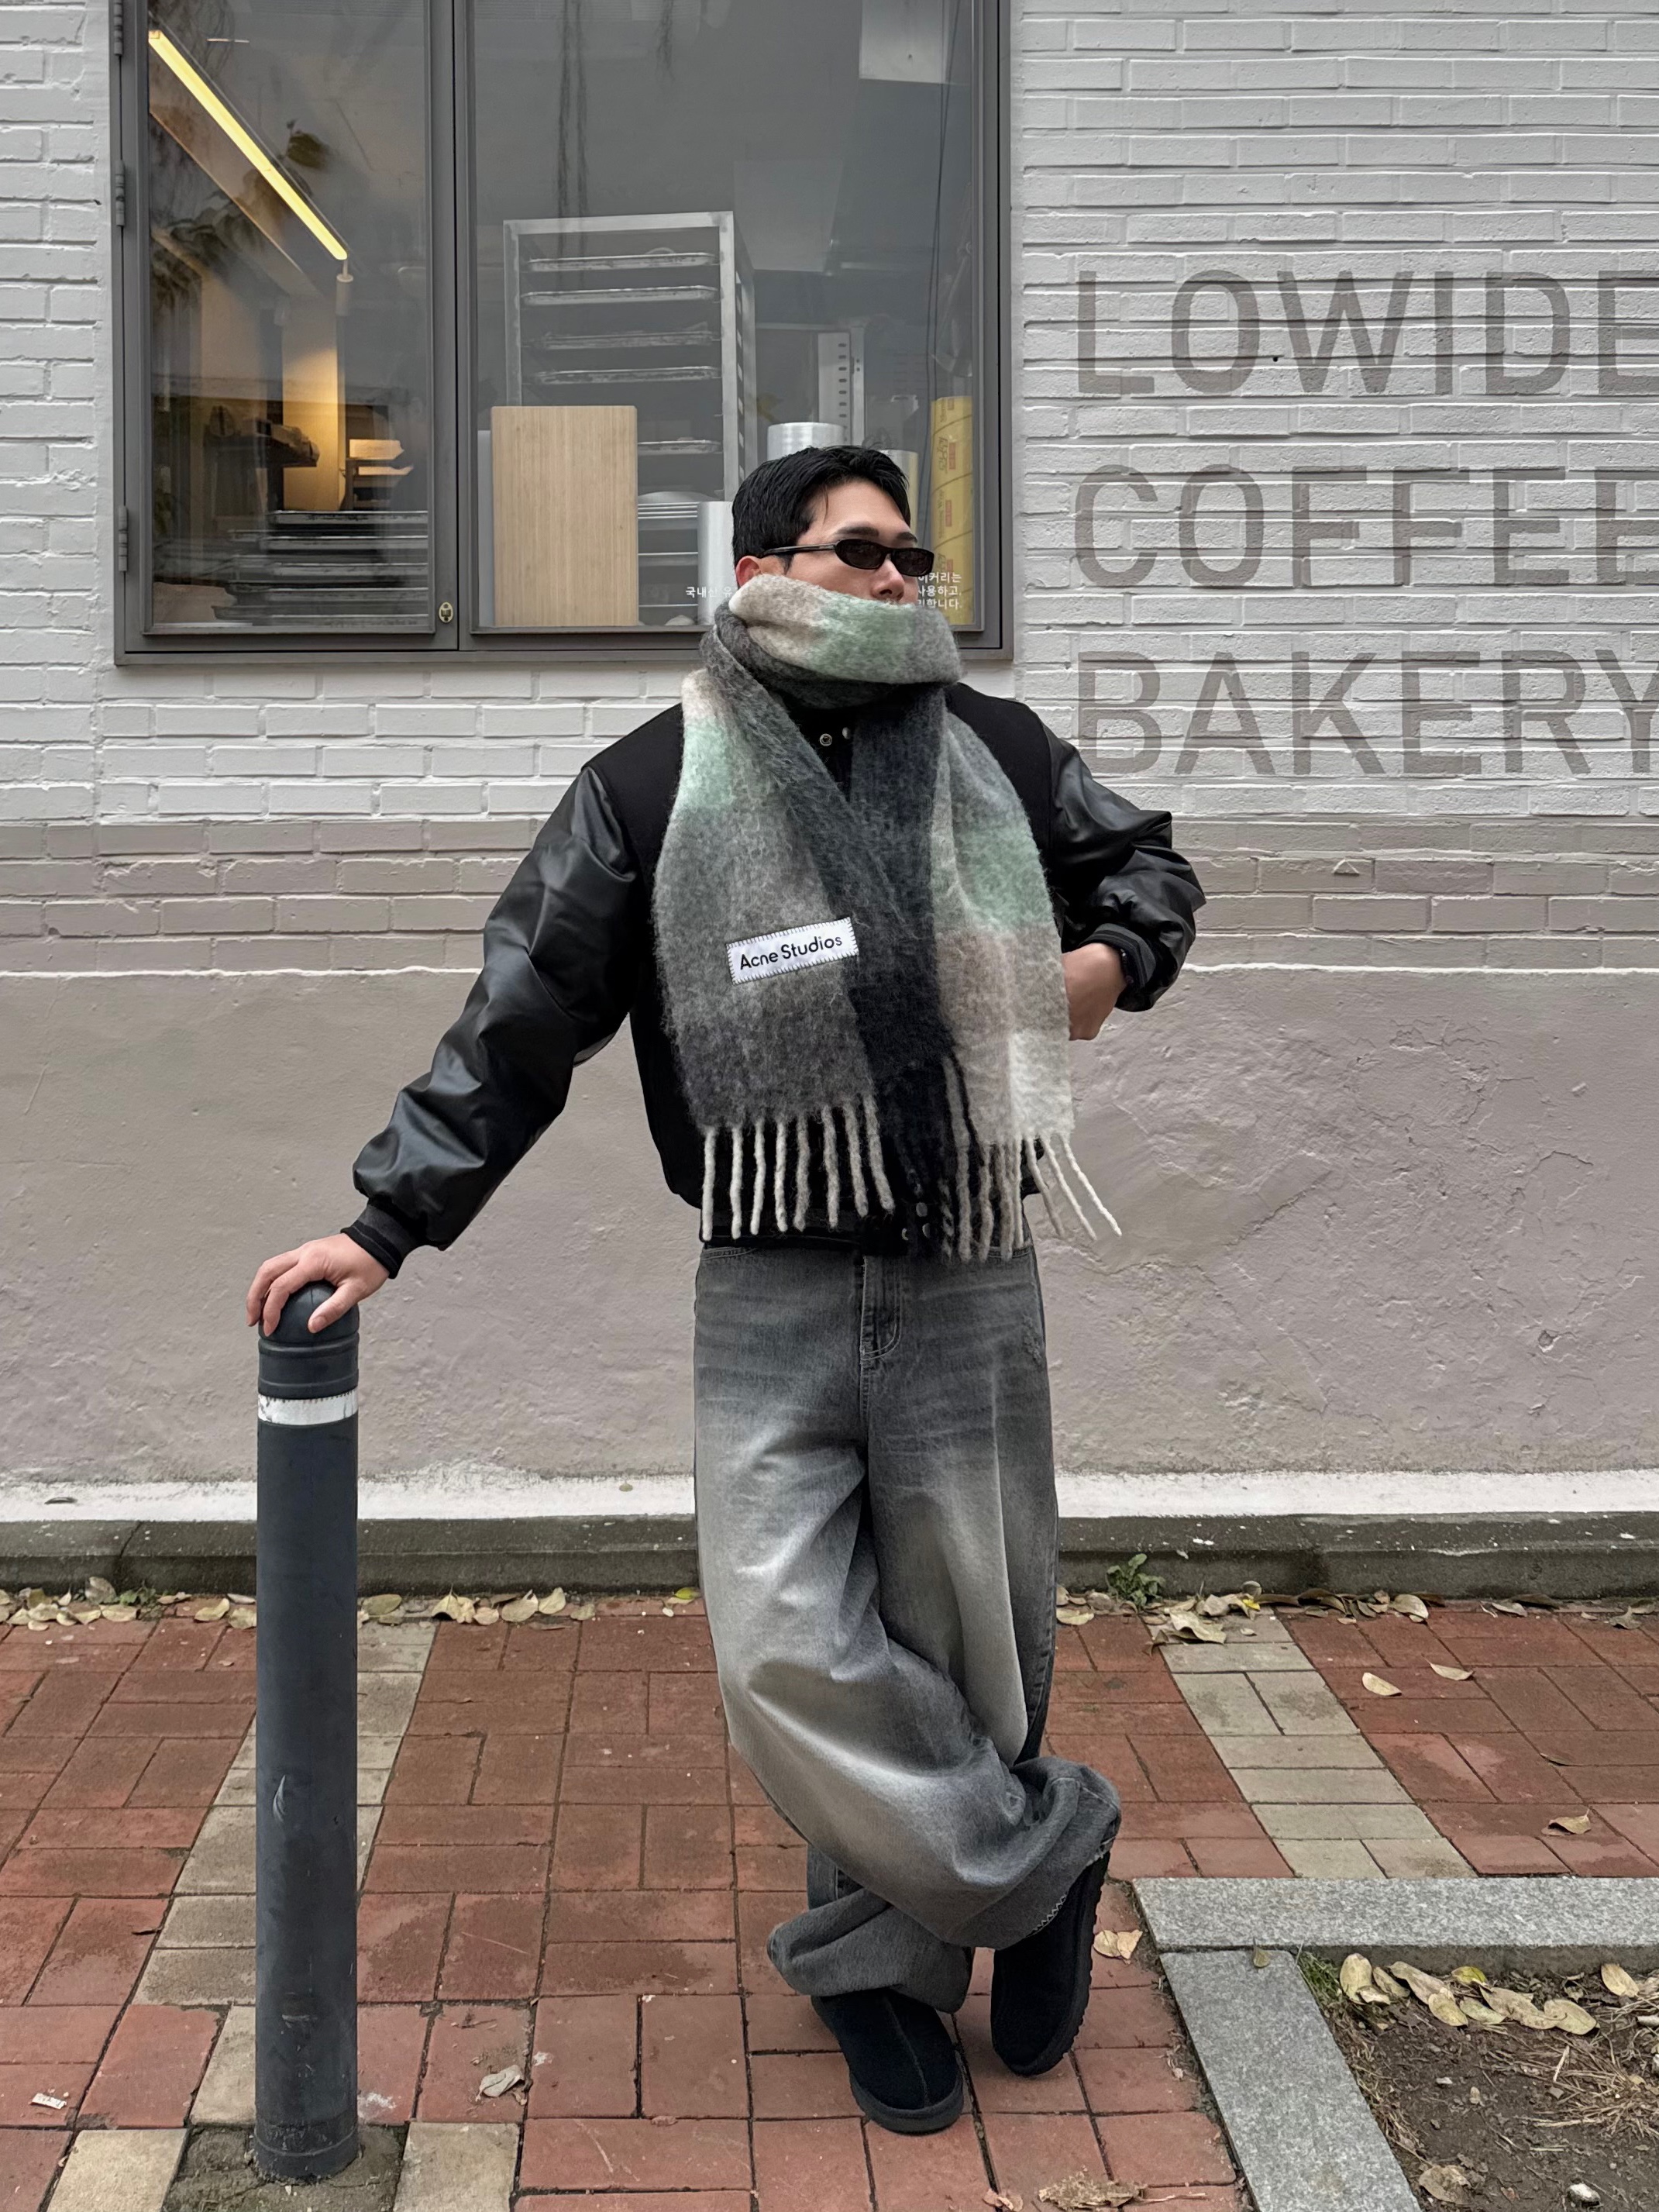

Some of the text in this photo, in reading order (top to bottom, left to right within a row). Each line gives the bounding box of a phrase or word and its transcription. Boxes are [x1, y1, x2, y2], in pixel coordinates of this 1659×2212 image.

[1077, 269, 1659, 395] LOWIDE
[1075, 464, 1659, 587] COFFEE
[685, 586, 718, 598] 국내산
[1077, 649, 1659, 776] BAKERY
[740, 935, 843, 970] Acne Studios
